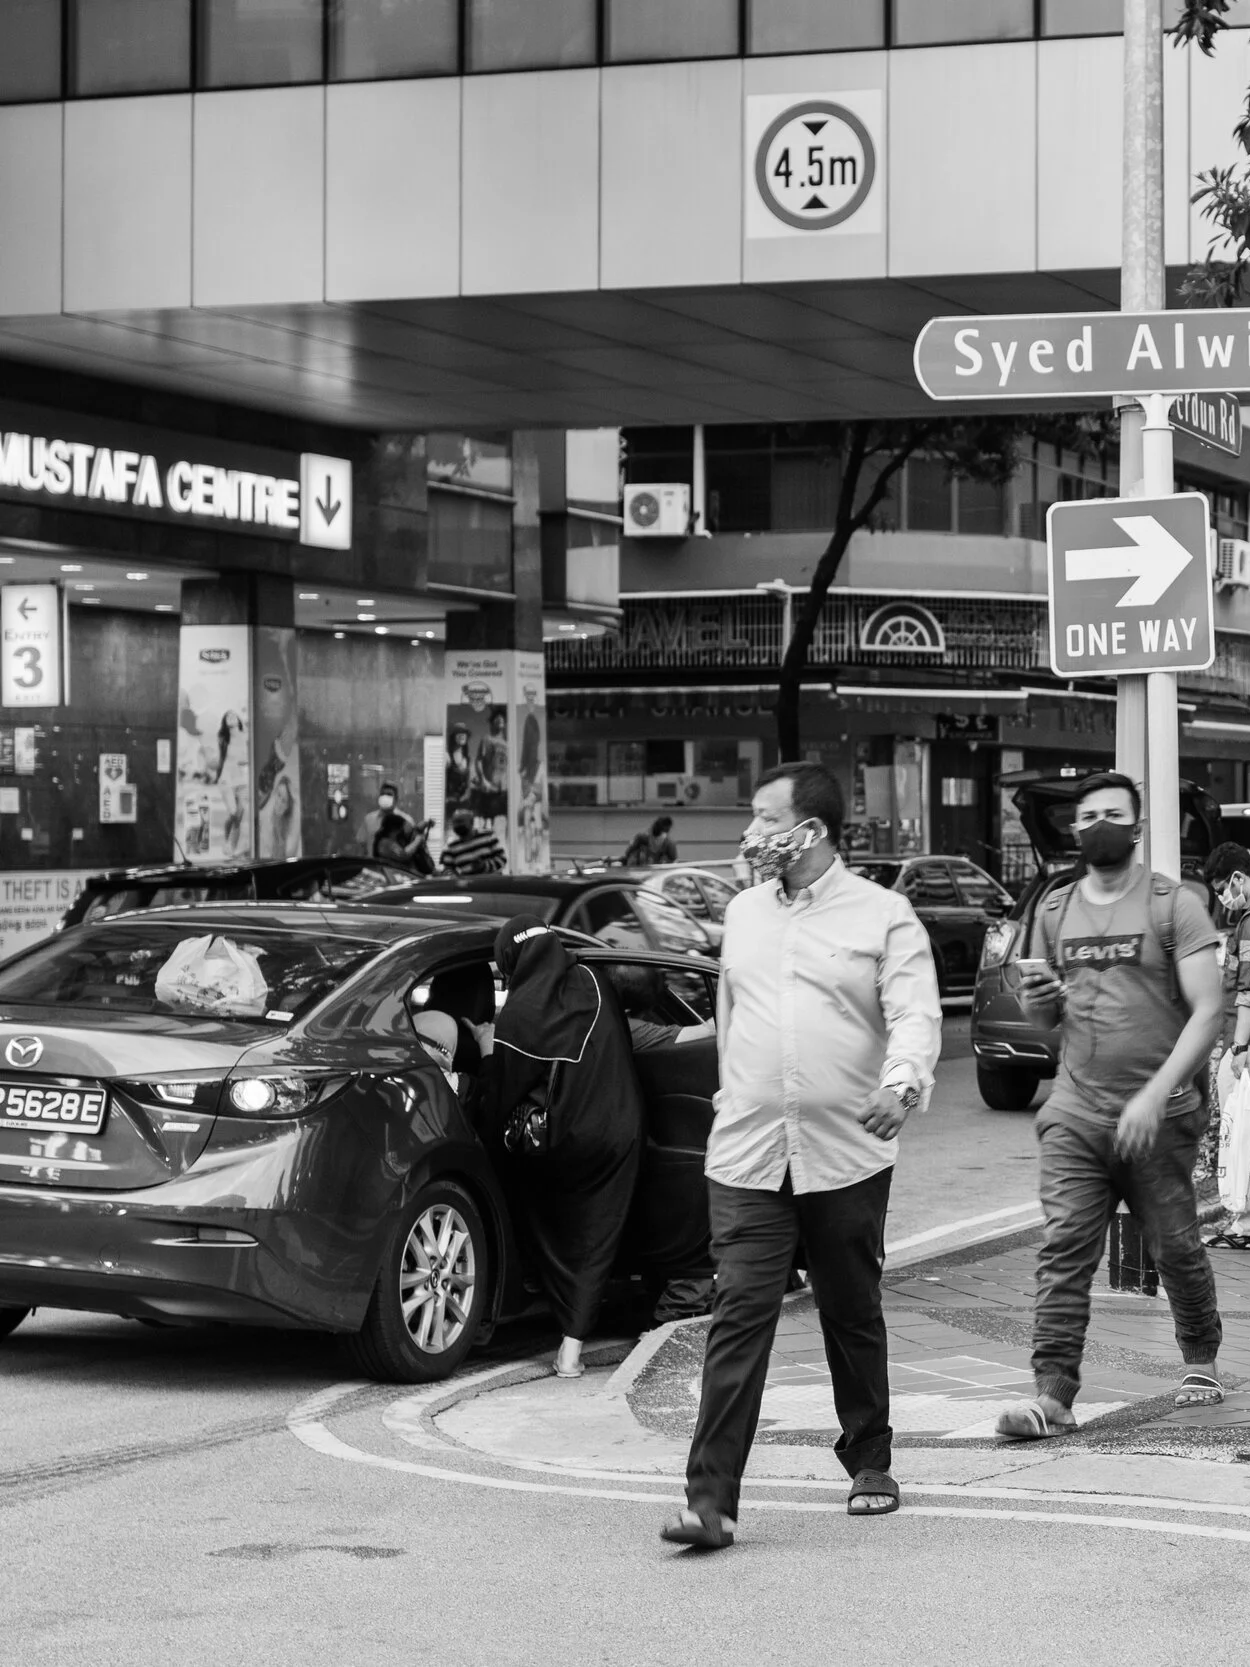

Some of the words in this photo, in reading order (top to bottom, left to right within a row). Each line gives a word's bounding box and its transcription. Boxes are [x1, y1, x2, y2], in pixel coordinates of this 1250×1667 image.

[774, 146, 857, 188] 4.5m
[954, 325, 1093, 387] Syed
[1175, 392, 1216, 436] erdun
[1220, 398, 1236, 446] Rd
[0, 432, 163, 508] MUSTAFA
[166, 460, 299, 528] CENTRE
[1066, 621, 1127, 658] ONE
[1139, 617, 1198, 654] WAY
[13, 646, 43, 688] 3
[3, 879, 52, 900] THEFT
[56, 879, 69, 899] IS
